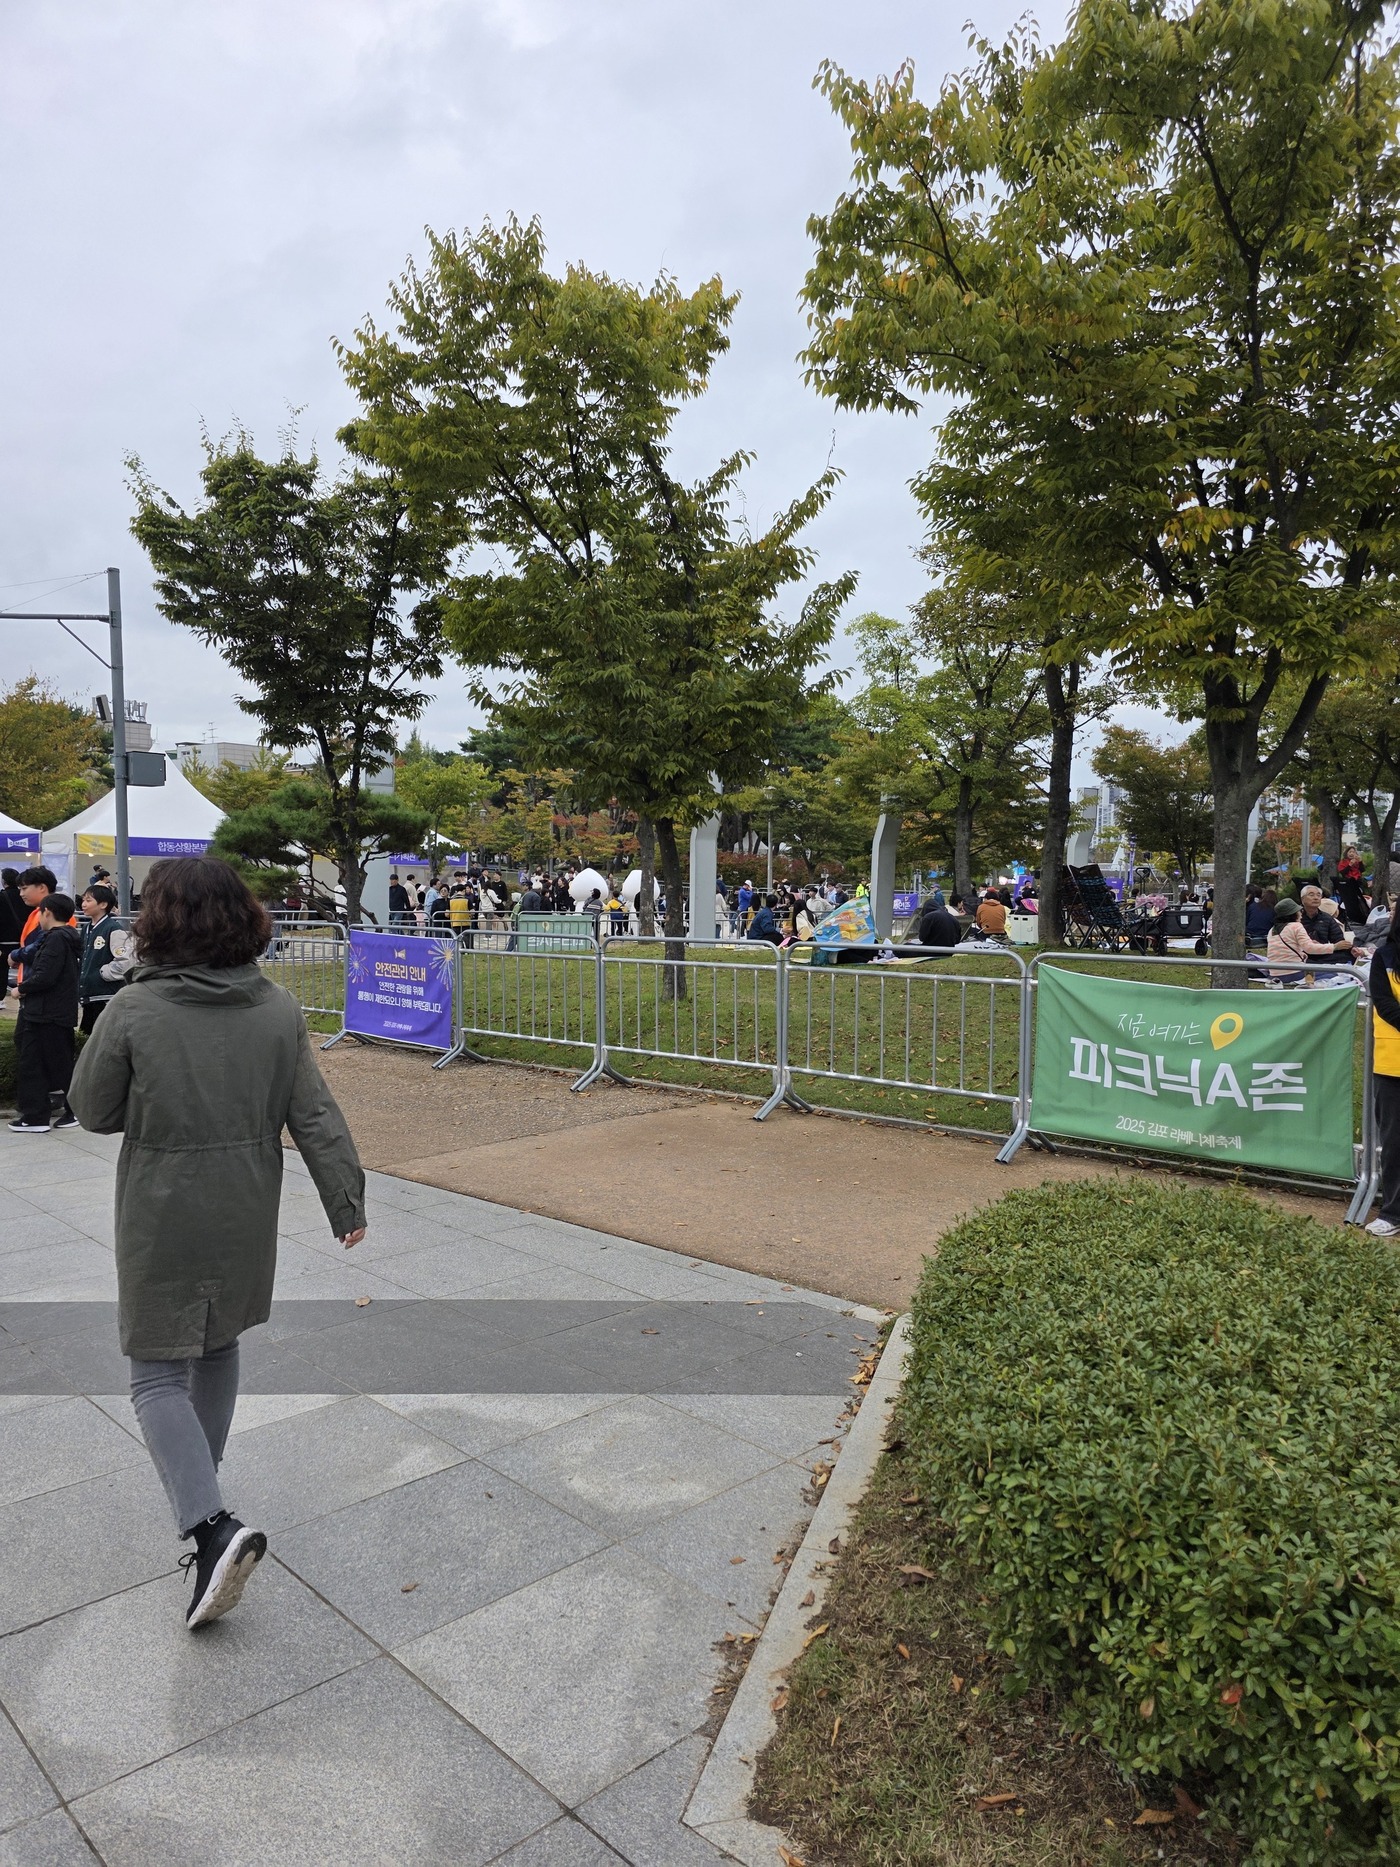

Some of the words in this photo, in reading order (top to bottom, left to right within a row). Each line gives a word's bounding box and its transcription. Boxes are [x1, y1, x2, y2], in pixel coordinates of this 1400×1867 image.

[157, 841, 208, 853] 합동상황본부
[375, 962, 408, 980] 안전관리
[409, 966, 426, 982] 안내
[378, 981, 395, 992] 안전한
[412, 985, 424, 997] 위해
[375, 993, 401, 1007] 제한되오니
[401, 997, 412, 1009] 양해
[412, 999, 443, 1013] 부탁드립니다.
[1117, 1013, 1145, 1039] 지금
[1149, 1022, 1204, 1045] 여기는
[1068, 1036, 1308, 1112] 피크닉A존
[1115, 1115, 1145, 1135] 2025
[1147, 1122, 1169, 1139] 김포
[1169, 1128, 1215, 1149] 라베니체
[1215, 1135, 1242, 1150] 축제
